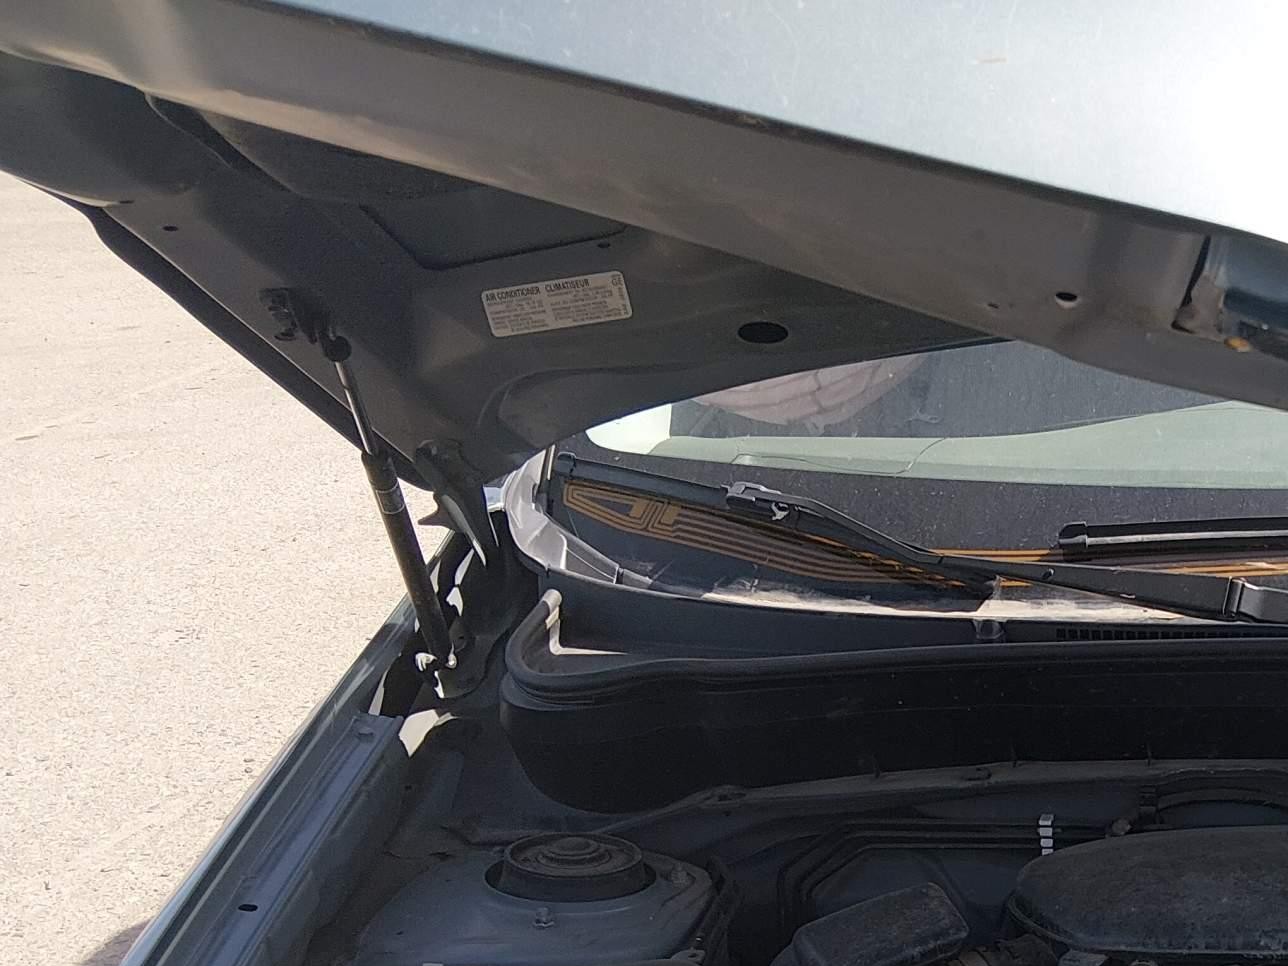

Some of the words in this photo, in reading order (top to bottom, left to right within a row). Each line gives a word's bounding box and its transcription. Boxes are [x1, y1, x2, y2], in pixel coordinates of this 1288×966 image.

[485, 293, 497, 302] AIR
[497, 286, 540, 300] CONDITIONER
[544, 278, 590, 292] CLIMATISEUR
